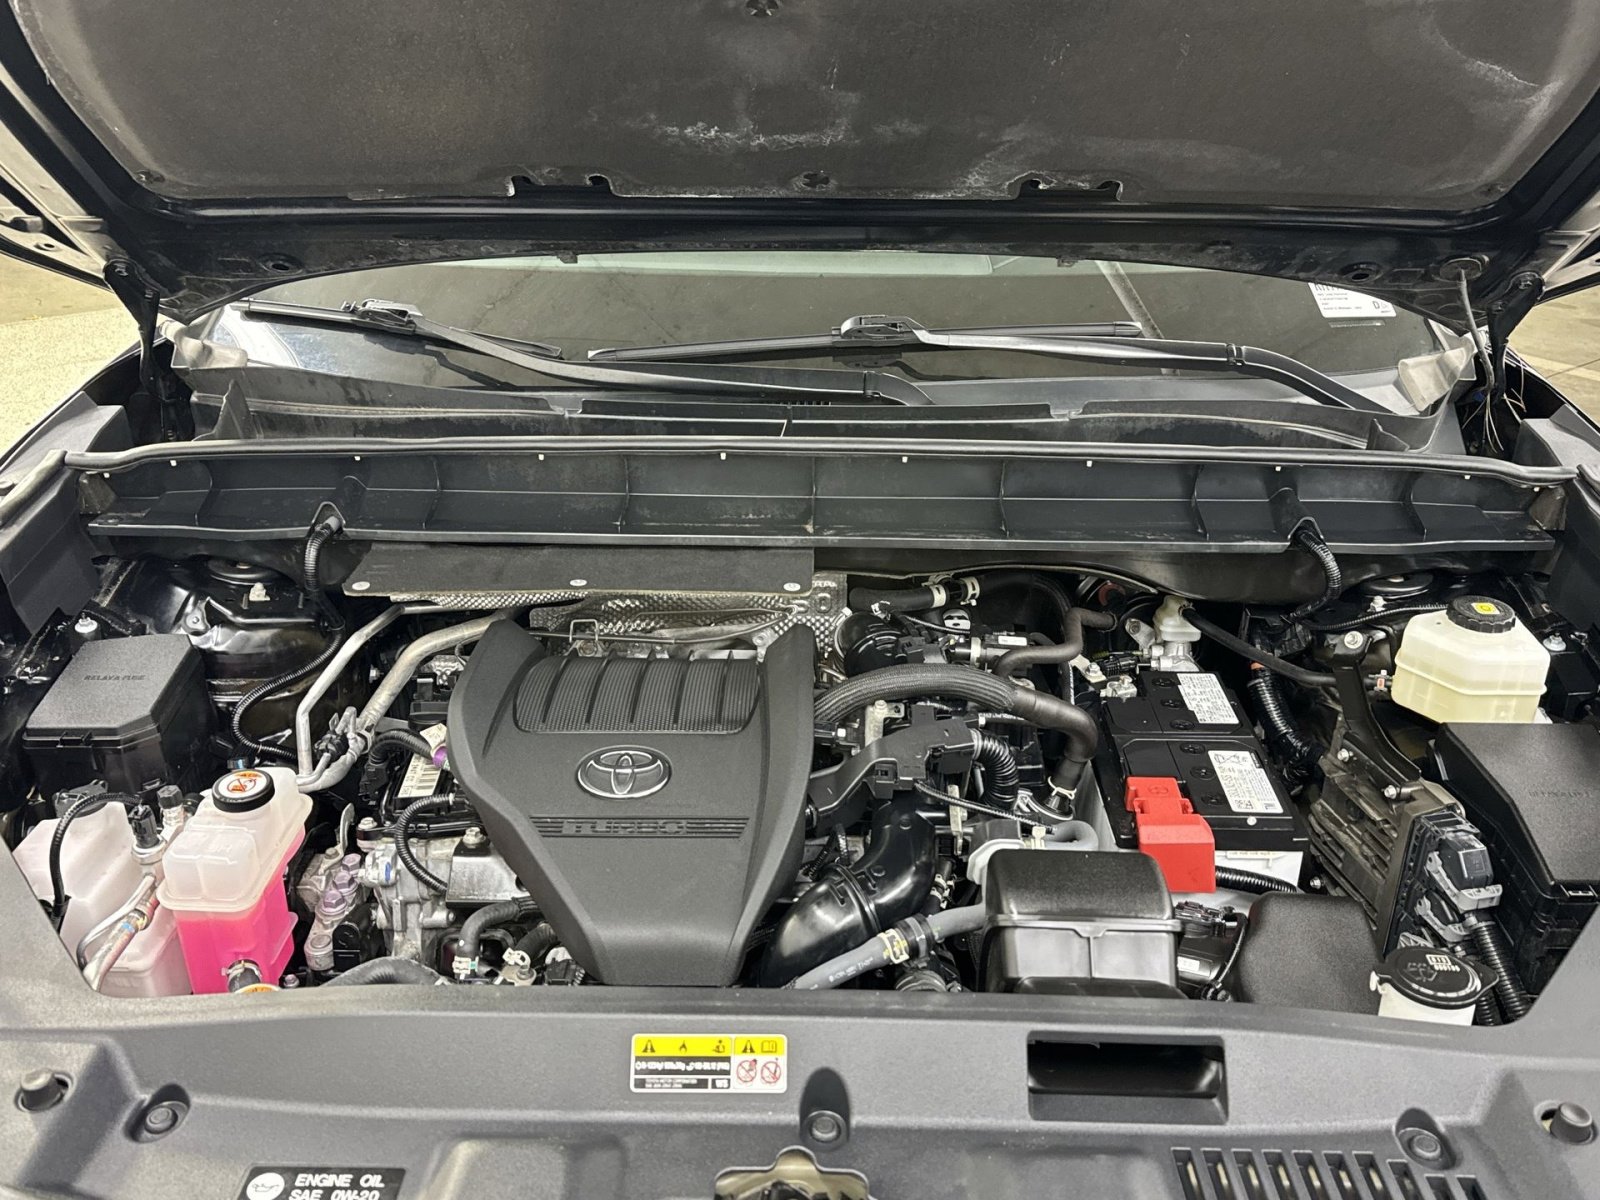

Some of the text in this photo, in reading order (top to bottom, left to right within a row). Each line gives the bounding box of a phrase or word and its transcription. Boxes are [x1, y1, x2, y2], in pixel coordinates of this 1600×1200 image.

[566, 820, 685, 834] TURBO
[294, 1173, 385, 1188] ENGINE OIL
[288, 1189, 381, 1200] SAE 0W-20
